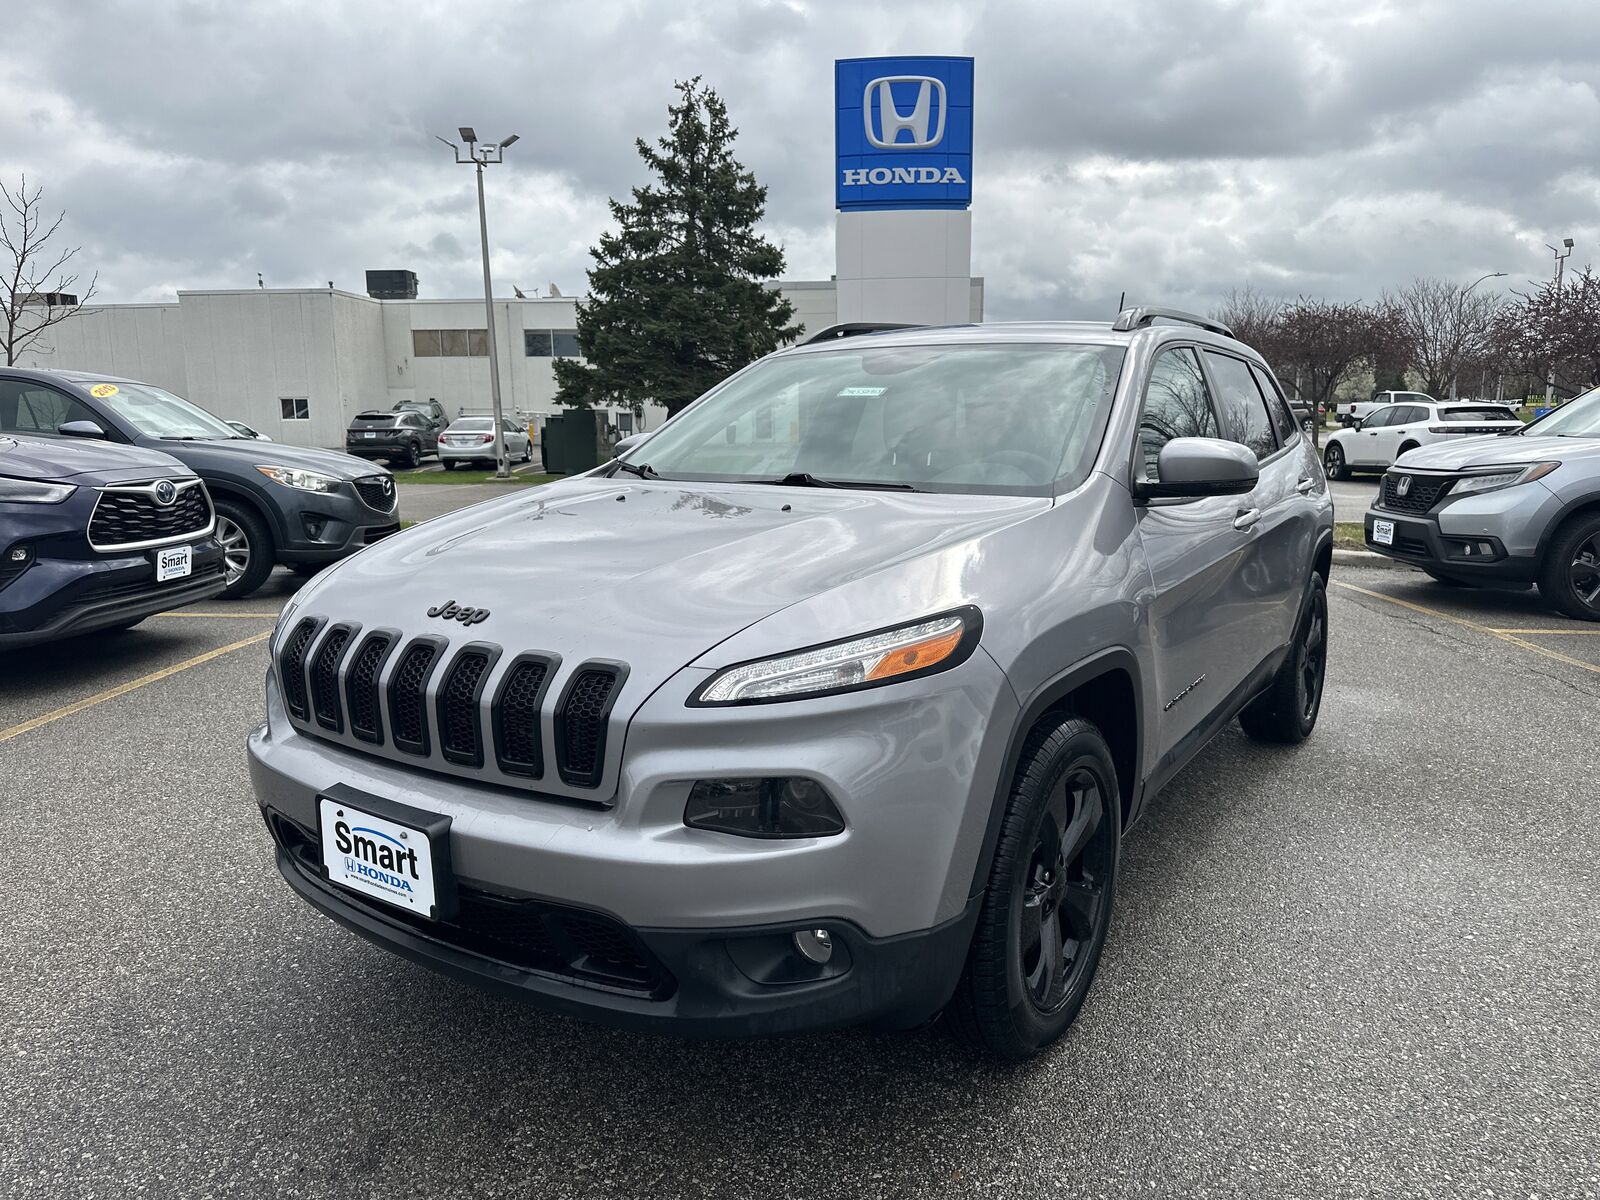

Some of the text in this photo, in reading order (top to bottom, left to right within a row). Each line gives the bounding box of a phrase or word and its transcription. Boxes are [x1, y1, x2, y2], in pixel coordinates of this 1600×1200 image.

[842, 167, 966, 186] HONDA
[161, 553, 188, 569] Smart
[426, 599, 491, 627] Jeep
[334, 820, 420, 881] Smart
[357, 862, 414, 893] HONDA
